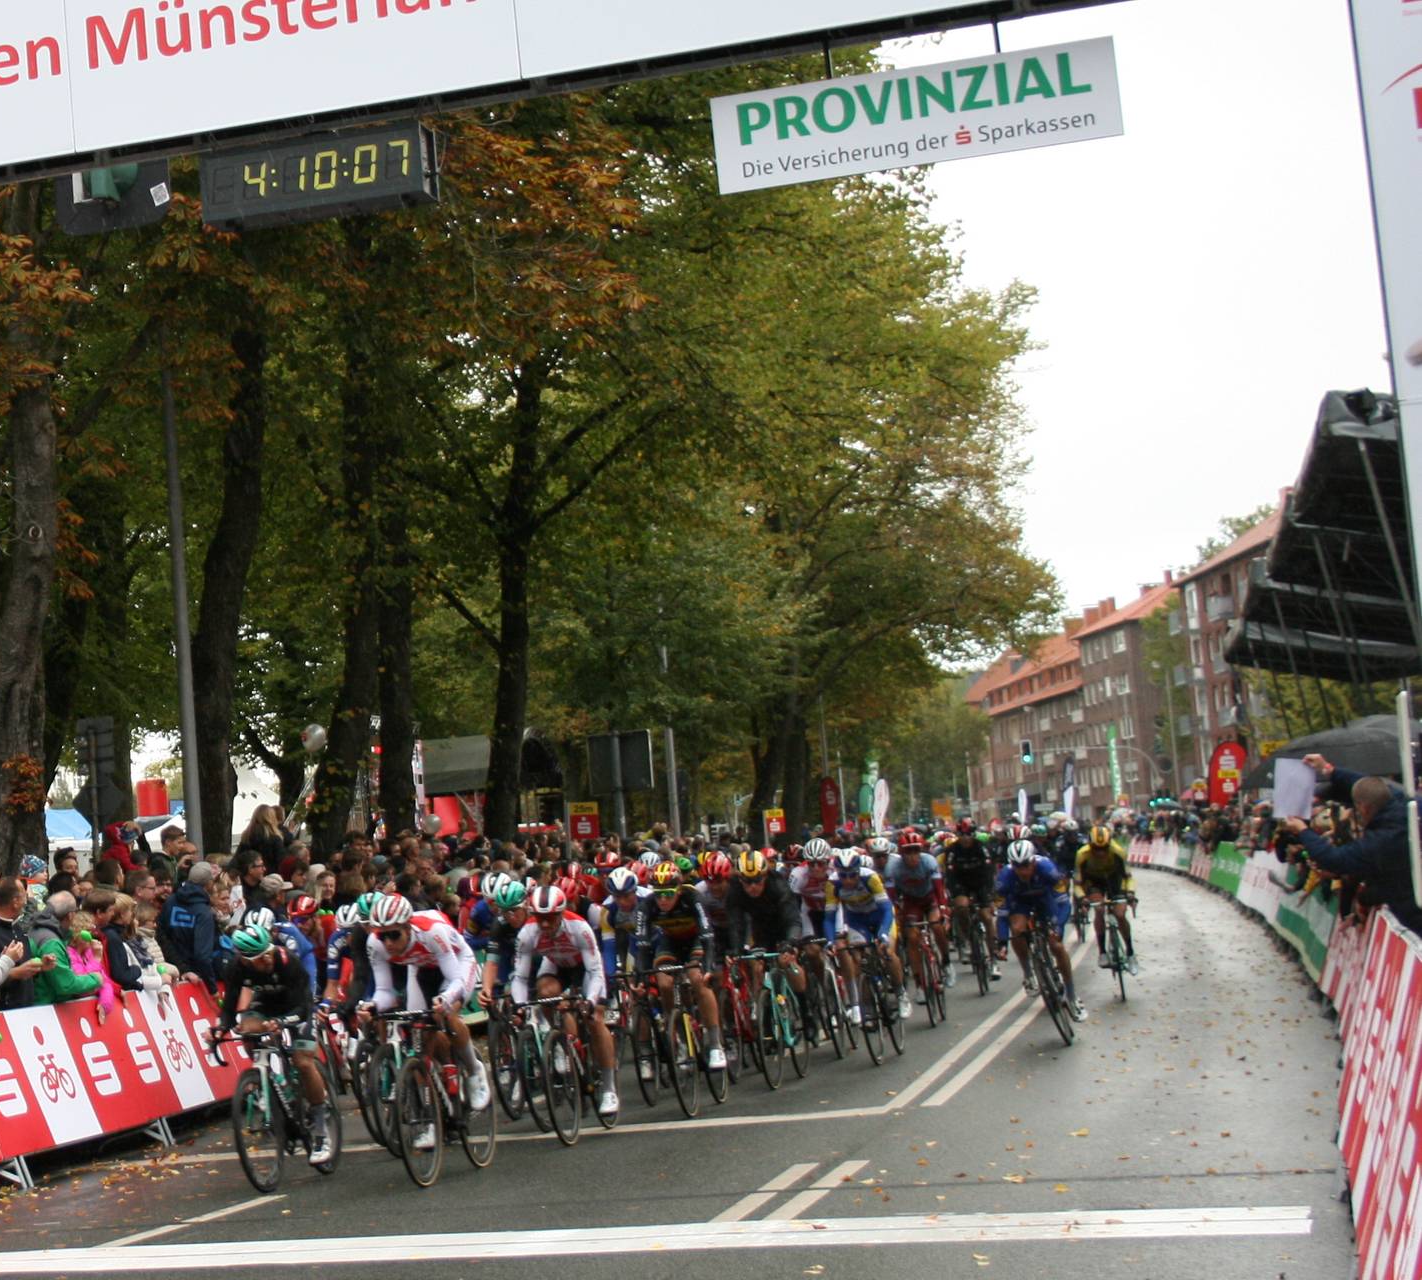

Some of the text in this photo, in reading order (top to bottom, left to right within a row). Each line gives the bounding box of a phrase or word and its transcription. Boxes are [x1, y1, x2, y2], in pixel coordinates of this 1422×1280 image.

[736, 53, 1092, 145] PROVINZIAL
[242, 139, 410, 197] 4:10:07
[743, 160, 773, 178] Die
[778, 142, 909, 171] Versicherung
[916, 134, 948, 151] der
[978, 114, 1095, 143] Sparkassen
